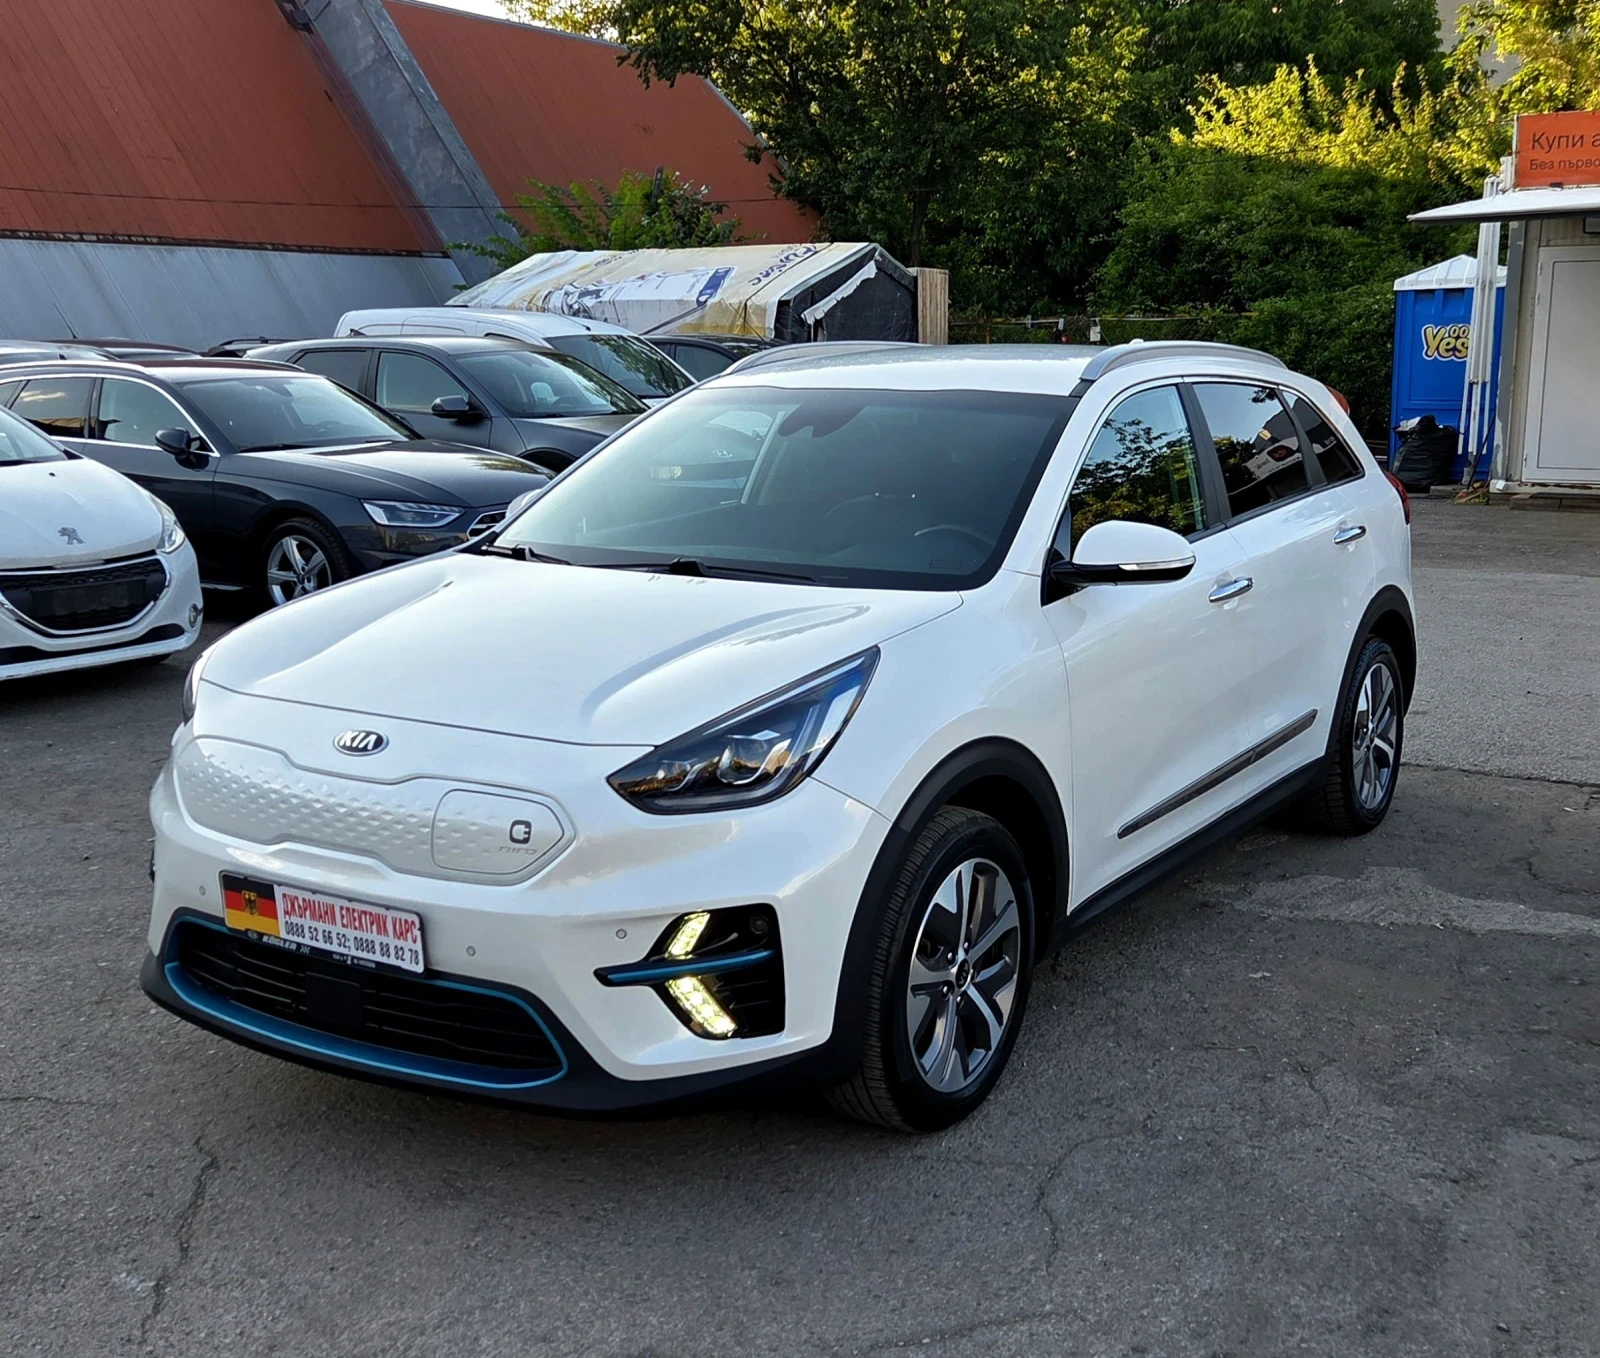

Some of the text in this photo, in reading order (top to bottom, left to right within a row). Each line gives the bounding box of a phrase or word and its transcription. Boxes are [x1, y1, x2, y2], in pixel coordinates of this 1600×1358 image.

[1531, 132, 1584, 154] Купи
[1529, 158, 1555, 171] Без
[1423, 326, 1469, 359] Yes
[339, 731, 378, 750] KIA
[282, 892, 418, 944] ДЖЪРМАНИ ЕЛЕКТРИК КАРС
[284, 920, 306, 940] 0888
[308, 925, 320, 943] 52
[322, 928, 334, 946] 66
[353, 936, 377, 955] 0888
[379, 941, 391, 960] 88
[394, 945, 406, 962] 82
[408, 948, 420, 966] 78
